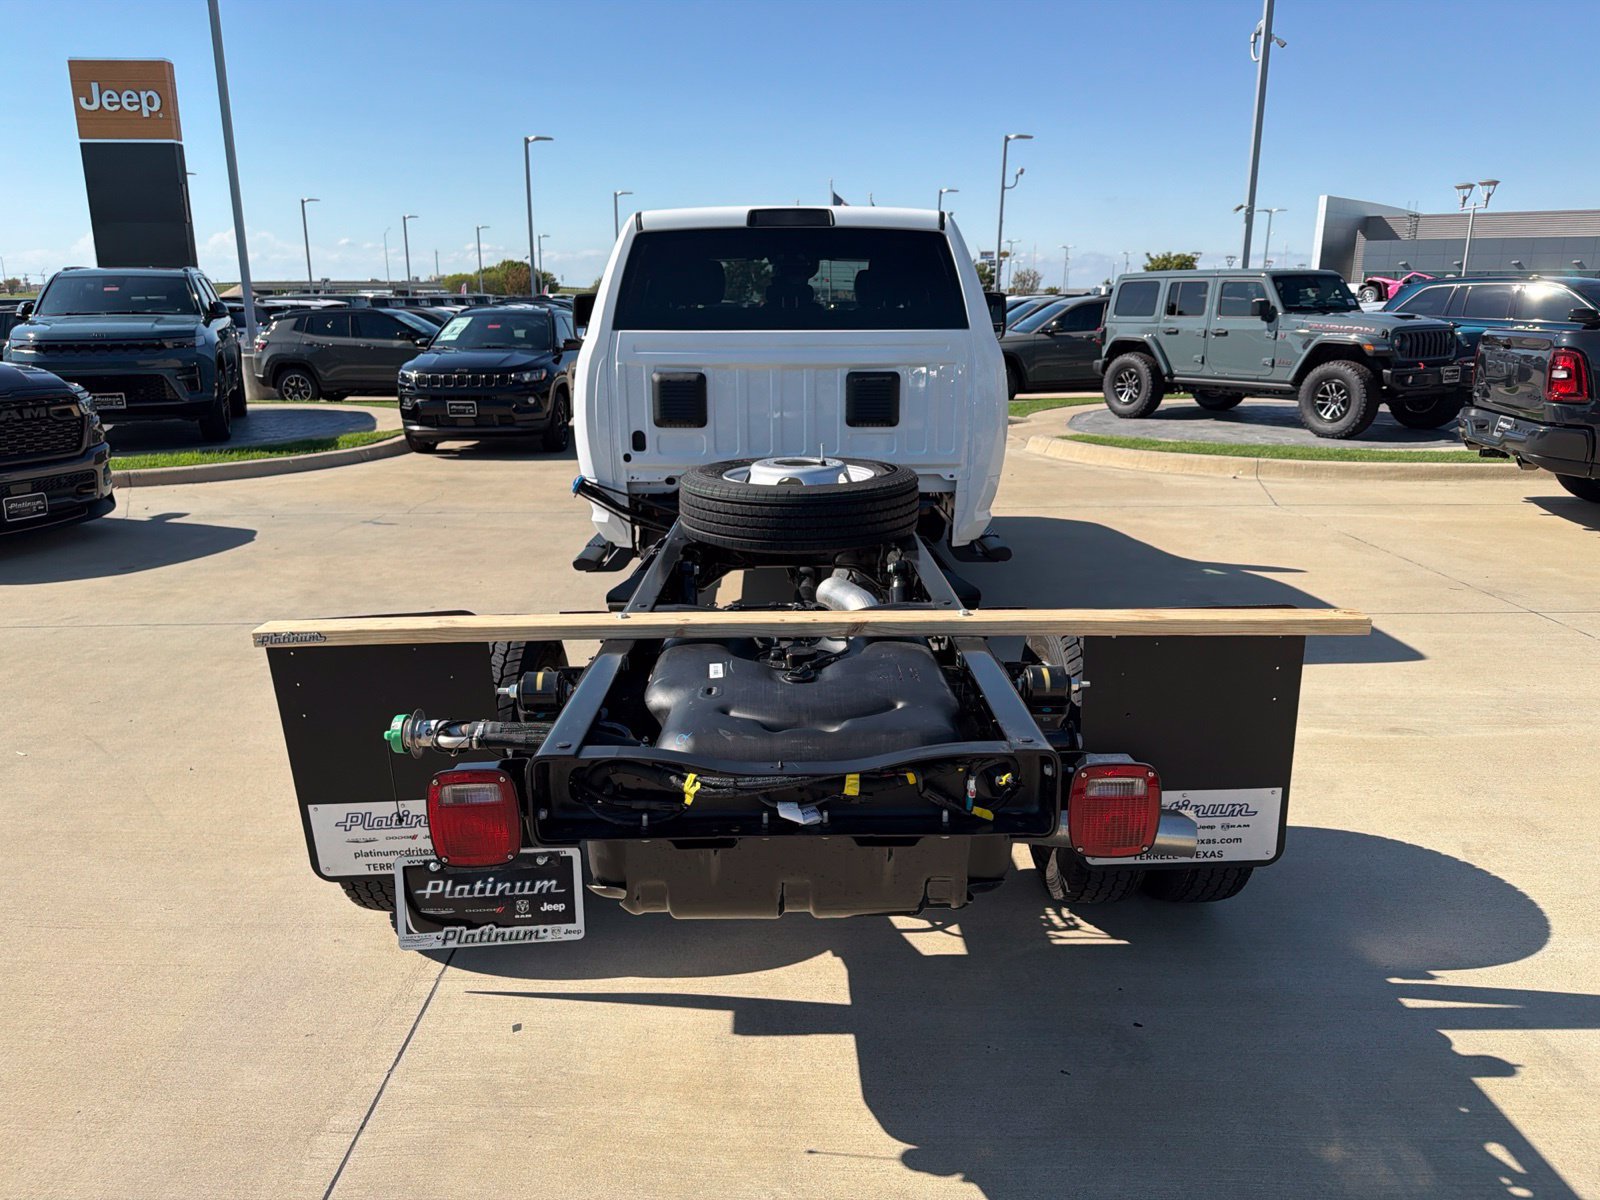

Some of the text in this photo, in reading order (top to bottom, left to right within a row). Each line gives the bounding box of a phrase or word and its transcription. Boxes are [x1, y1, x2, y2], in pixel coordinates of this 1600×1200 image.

[79, 82, 161, 118] Jeep
[1309, 323, 1376, 333] RUBICON
[0, 407, 47, 420] AM
[256, 632, 327, 645] Platinum
[335, 810, 430, 832] Platin
[1191, 850, 1224, 859] EXAS
[415, 877, 566, 899] Platinum
[540, 902, 566, 912] Jeep
[441, 924, 547, 946] Platinum
